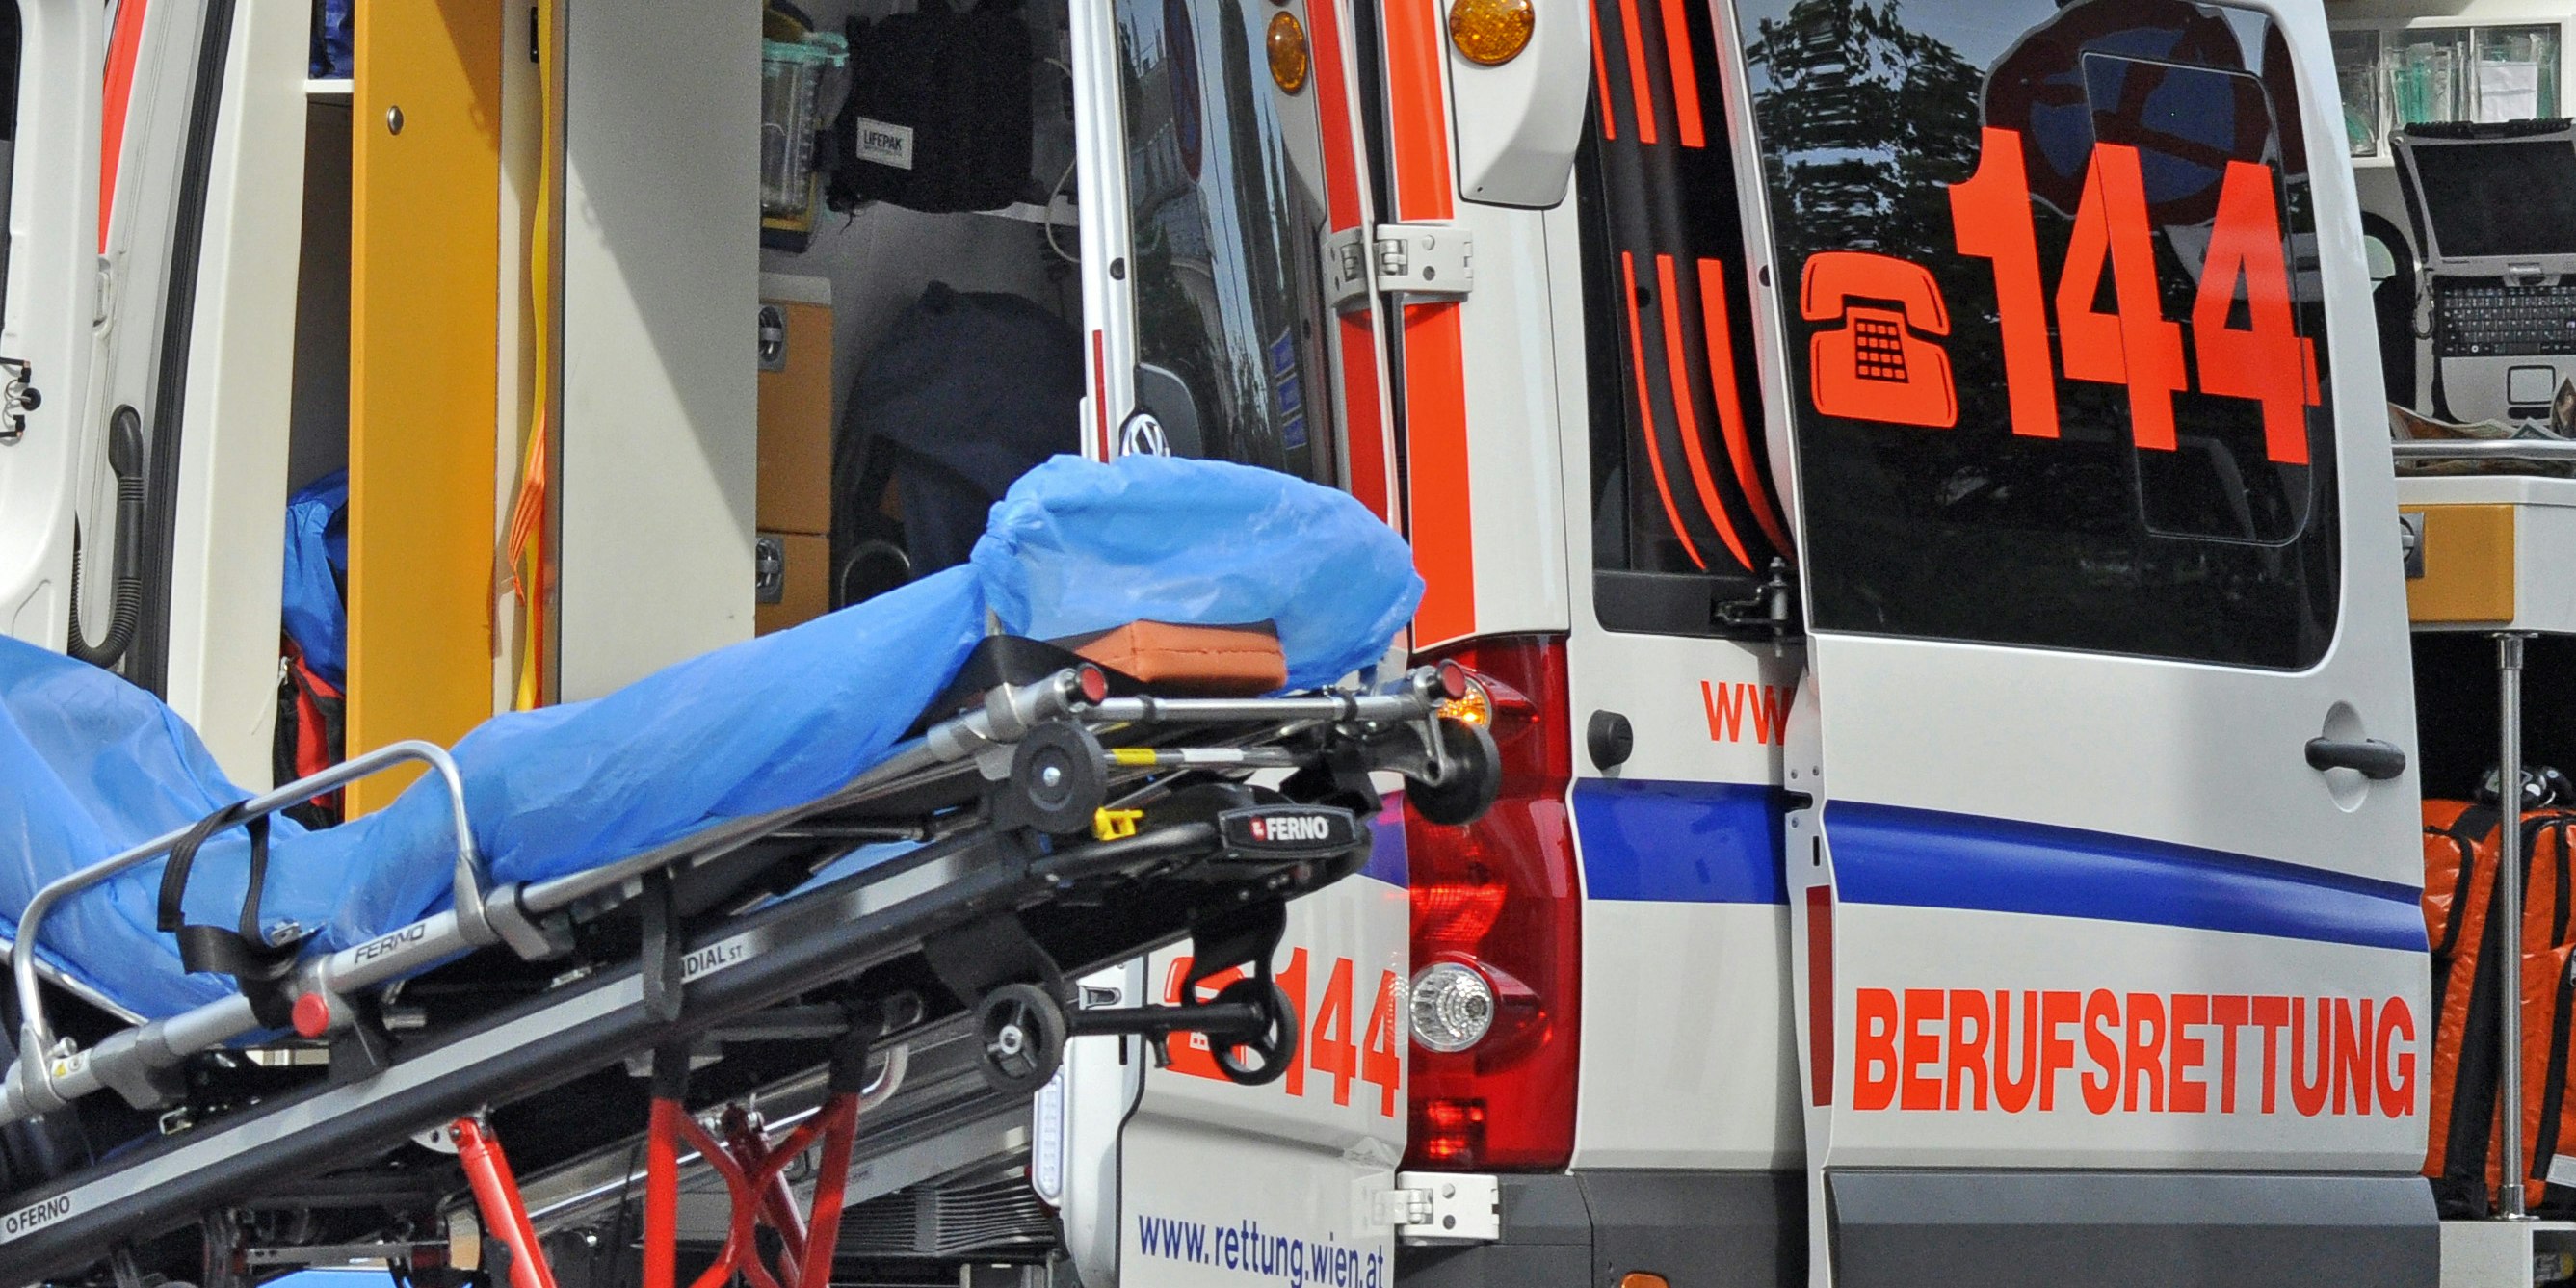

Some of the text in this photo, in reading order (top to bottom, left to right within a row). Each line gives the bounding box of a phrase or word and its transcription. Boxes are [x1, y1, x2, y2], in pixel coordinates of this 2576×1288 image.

[863, 129, 903, 151] LIFEPAK
[1948, 126, 2321, 465] 144
[1266, 816, 1329, 840] FERNO
[355, 923, 426, 964] FERNO
[1275, 947, 1400, 1117] 144
[1853, 987, 2416, 1119] BERUFSRETTUNG
[20, 1196, 70, 1230] FERNO
[1139, 1215, 1384, 1288] www.rettung.wien.at
